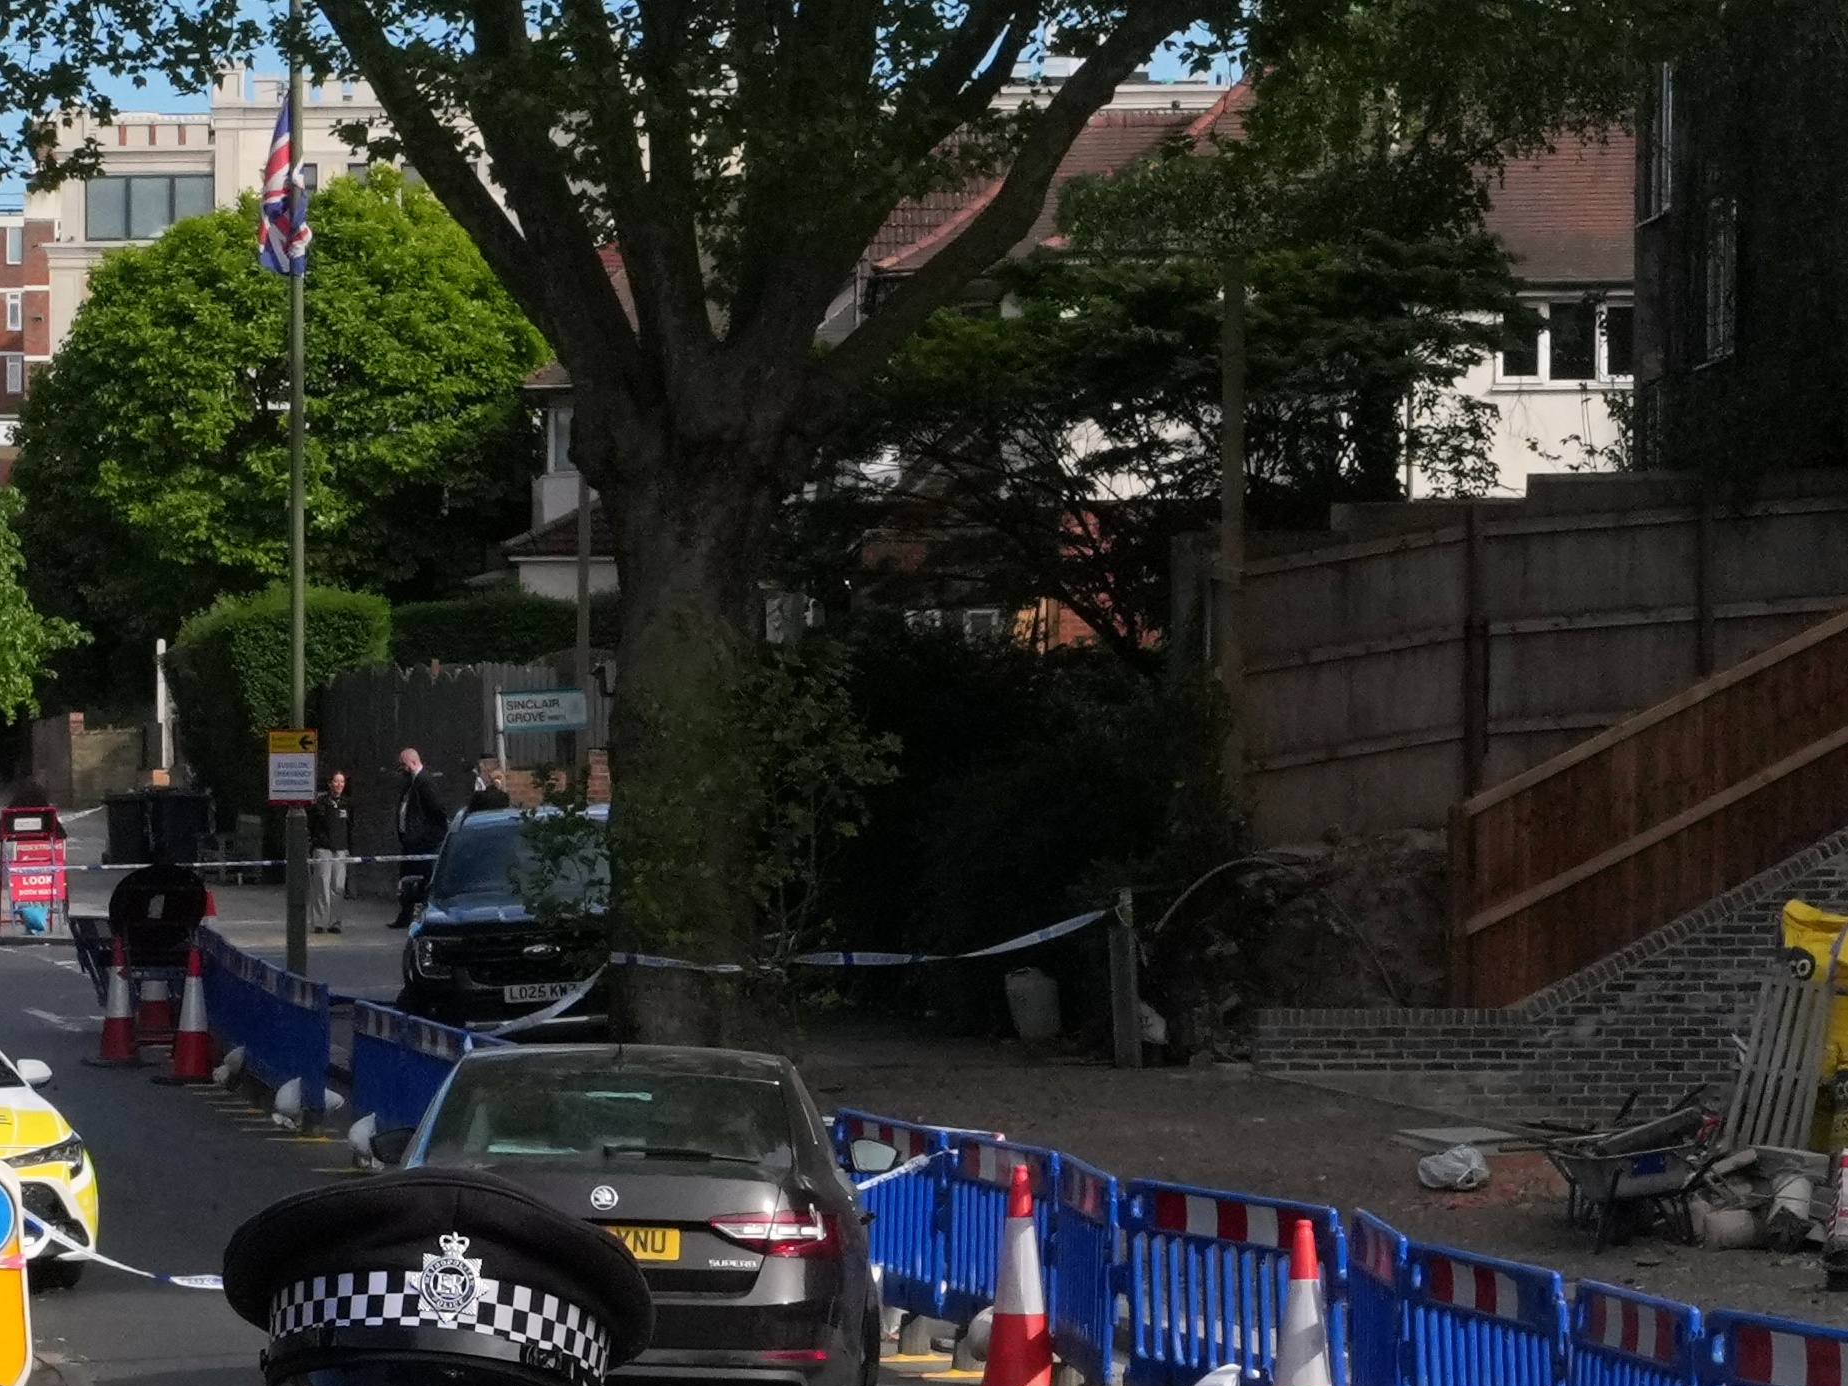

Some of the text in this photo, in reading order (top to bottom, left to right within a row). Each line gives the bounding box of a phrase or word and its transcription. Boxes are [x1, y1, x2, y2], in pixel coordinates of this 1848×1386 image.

[506, 699, 561, 711] SINCLAIR
[506, 712, 546, 724] GROVE
[23, 875, 53, 886] LOOK
